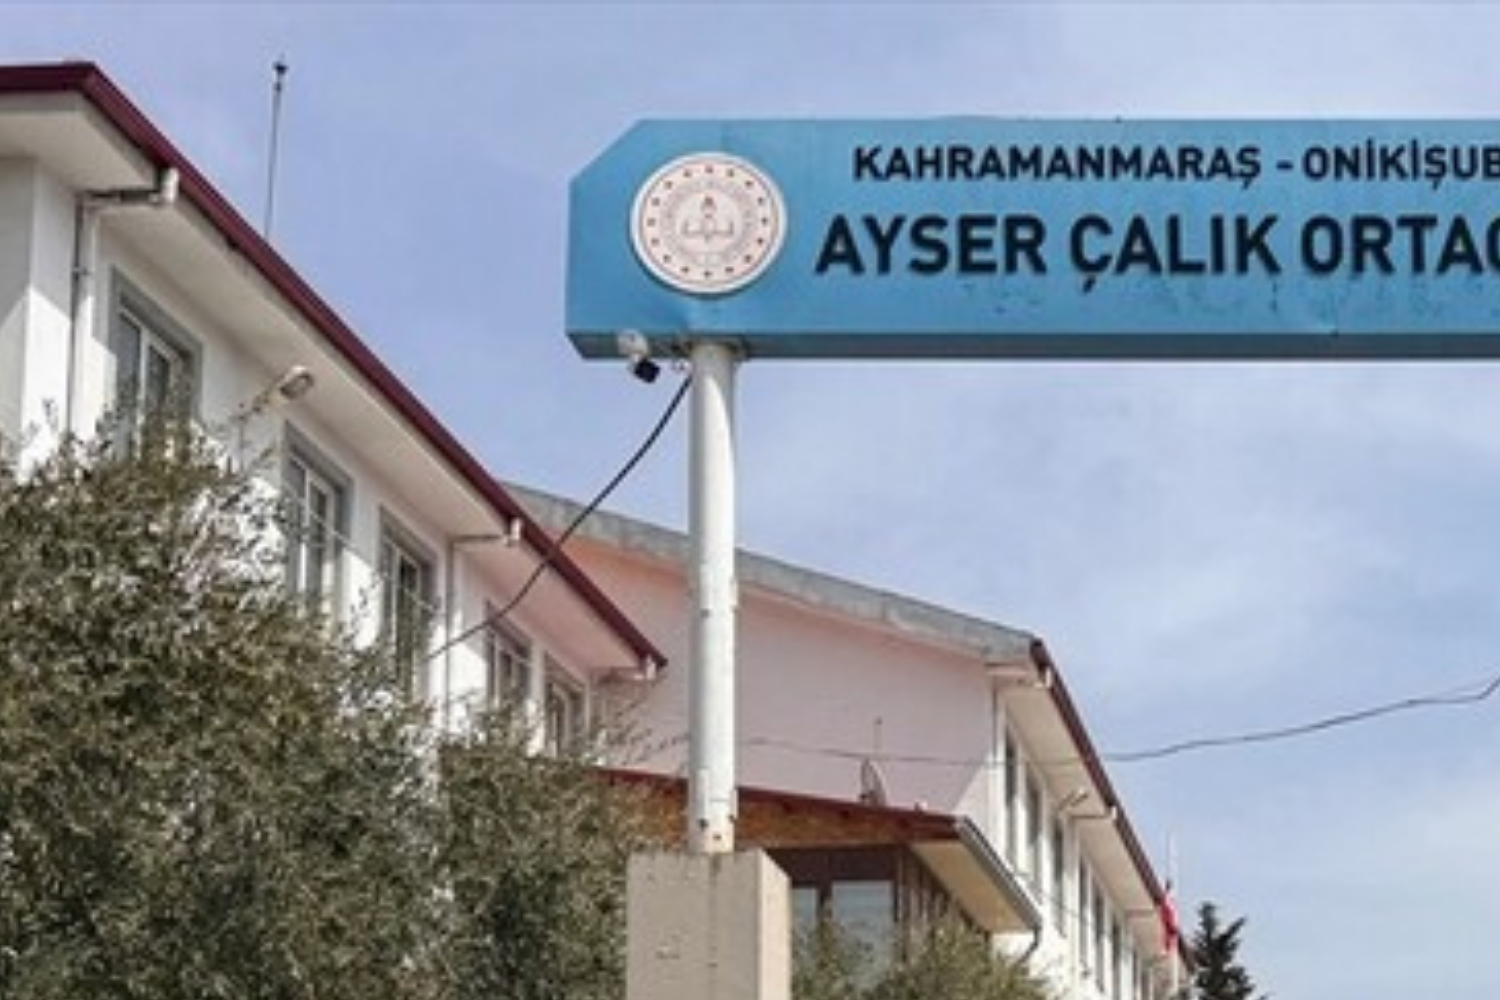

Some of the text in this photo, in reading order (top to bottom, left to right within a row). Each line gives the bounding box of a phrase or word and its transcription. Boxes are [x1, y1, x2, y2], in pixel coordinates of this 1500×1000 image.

[853, 145, 1261, 190] KAHRAMANMARAŞ
[815, 213, 1048, 276] AYSER
[1069, 213, 1282, 294] ÇALIK
